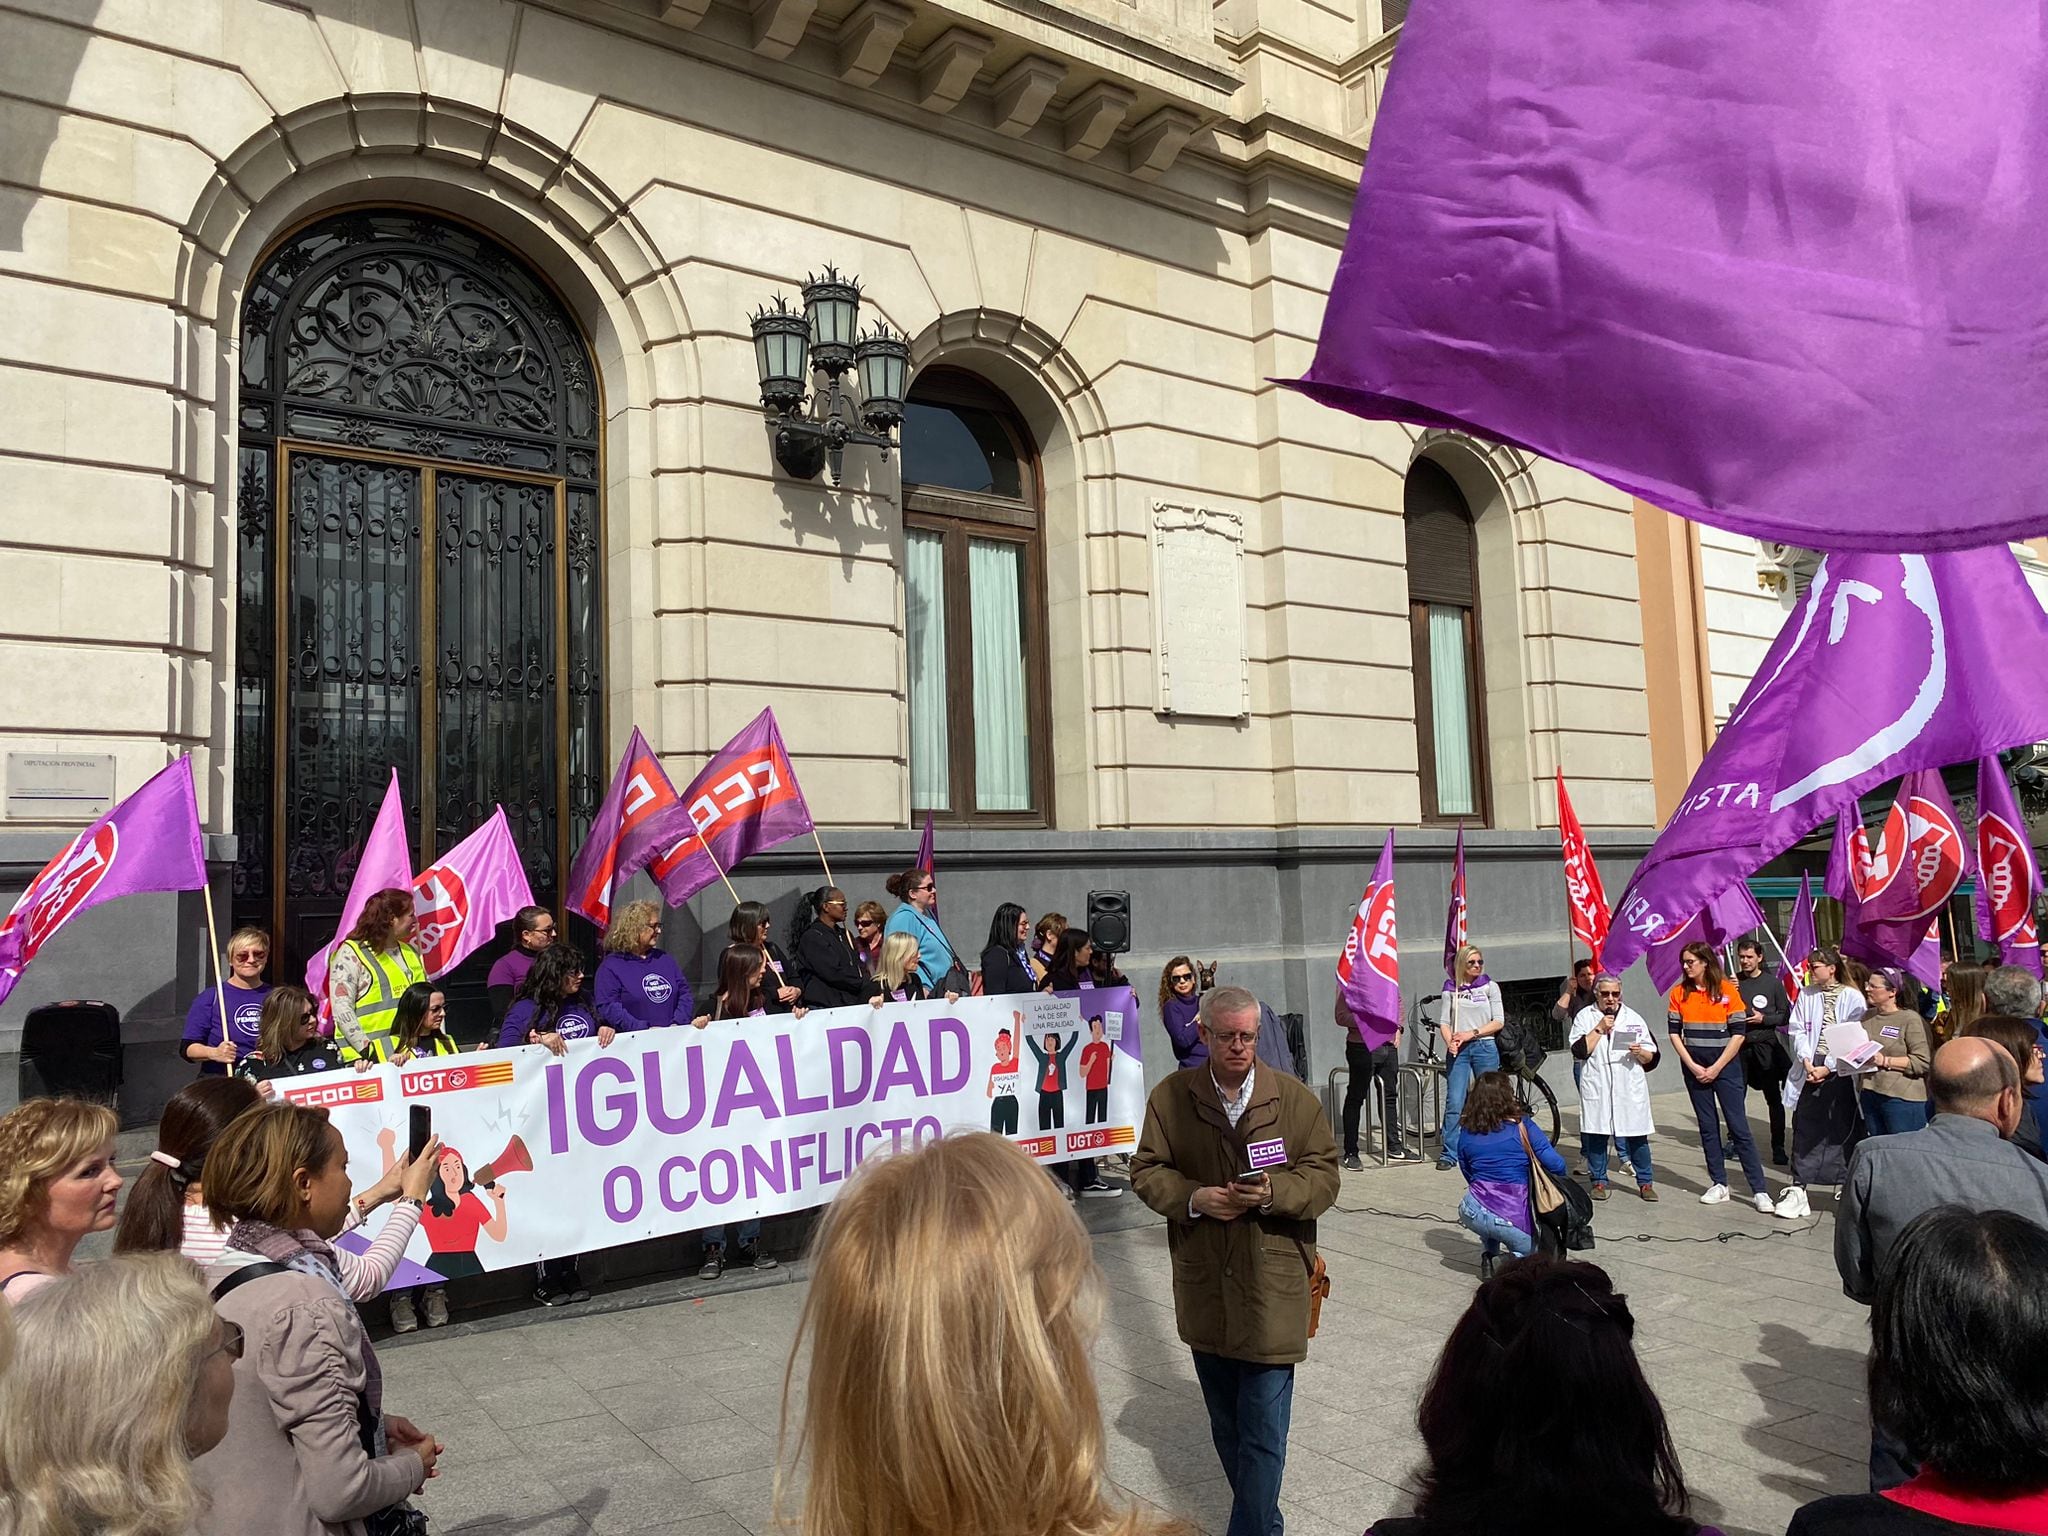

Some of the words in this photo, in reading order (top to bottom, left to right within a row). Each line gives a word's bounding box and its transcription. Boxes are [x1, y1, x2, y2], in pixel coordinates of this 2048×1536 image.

[1043, 1002, 1072, 1011] IGUALDAD
[1056, 1011, 1068, 1019] SER
[1032, 1022, 1046, 1030] UNA
[1046, 1020, 1075, 1029] REALIDAD
[404, 1071, 446, 1093] UGT
[993, 1073, 1020, 1082] IGUALDAD
[545, 1017, 971, 1154] IGUALDAD
[997, 1081, 1016, 1095] YA!
[290, 1086, 354, 1107] CCOO
[1068, 1133, 1093, 1150] UGT
[1251, 1143, 1283, 1158] CCOO
[602, 1164, 643, 1224] O
